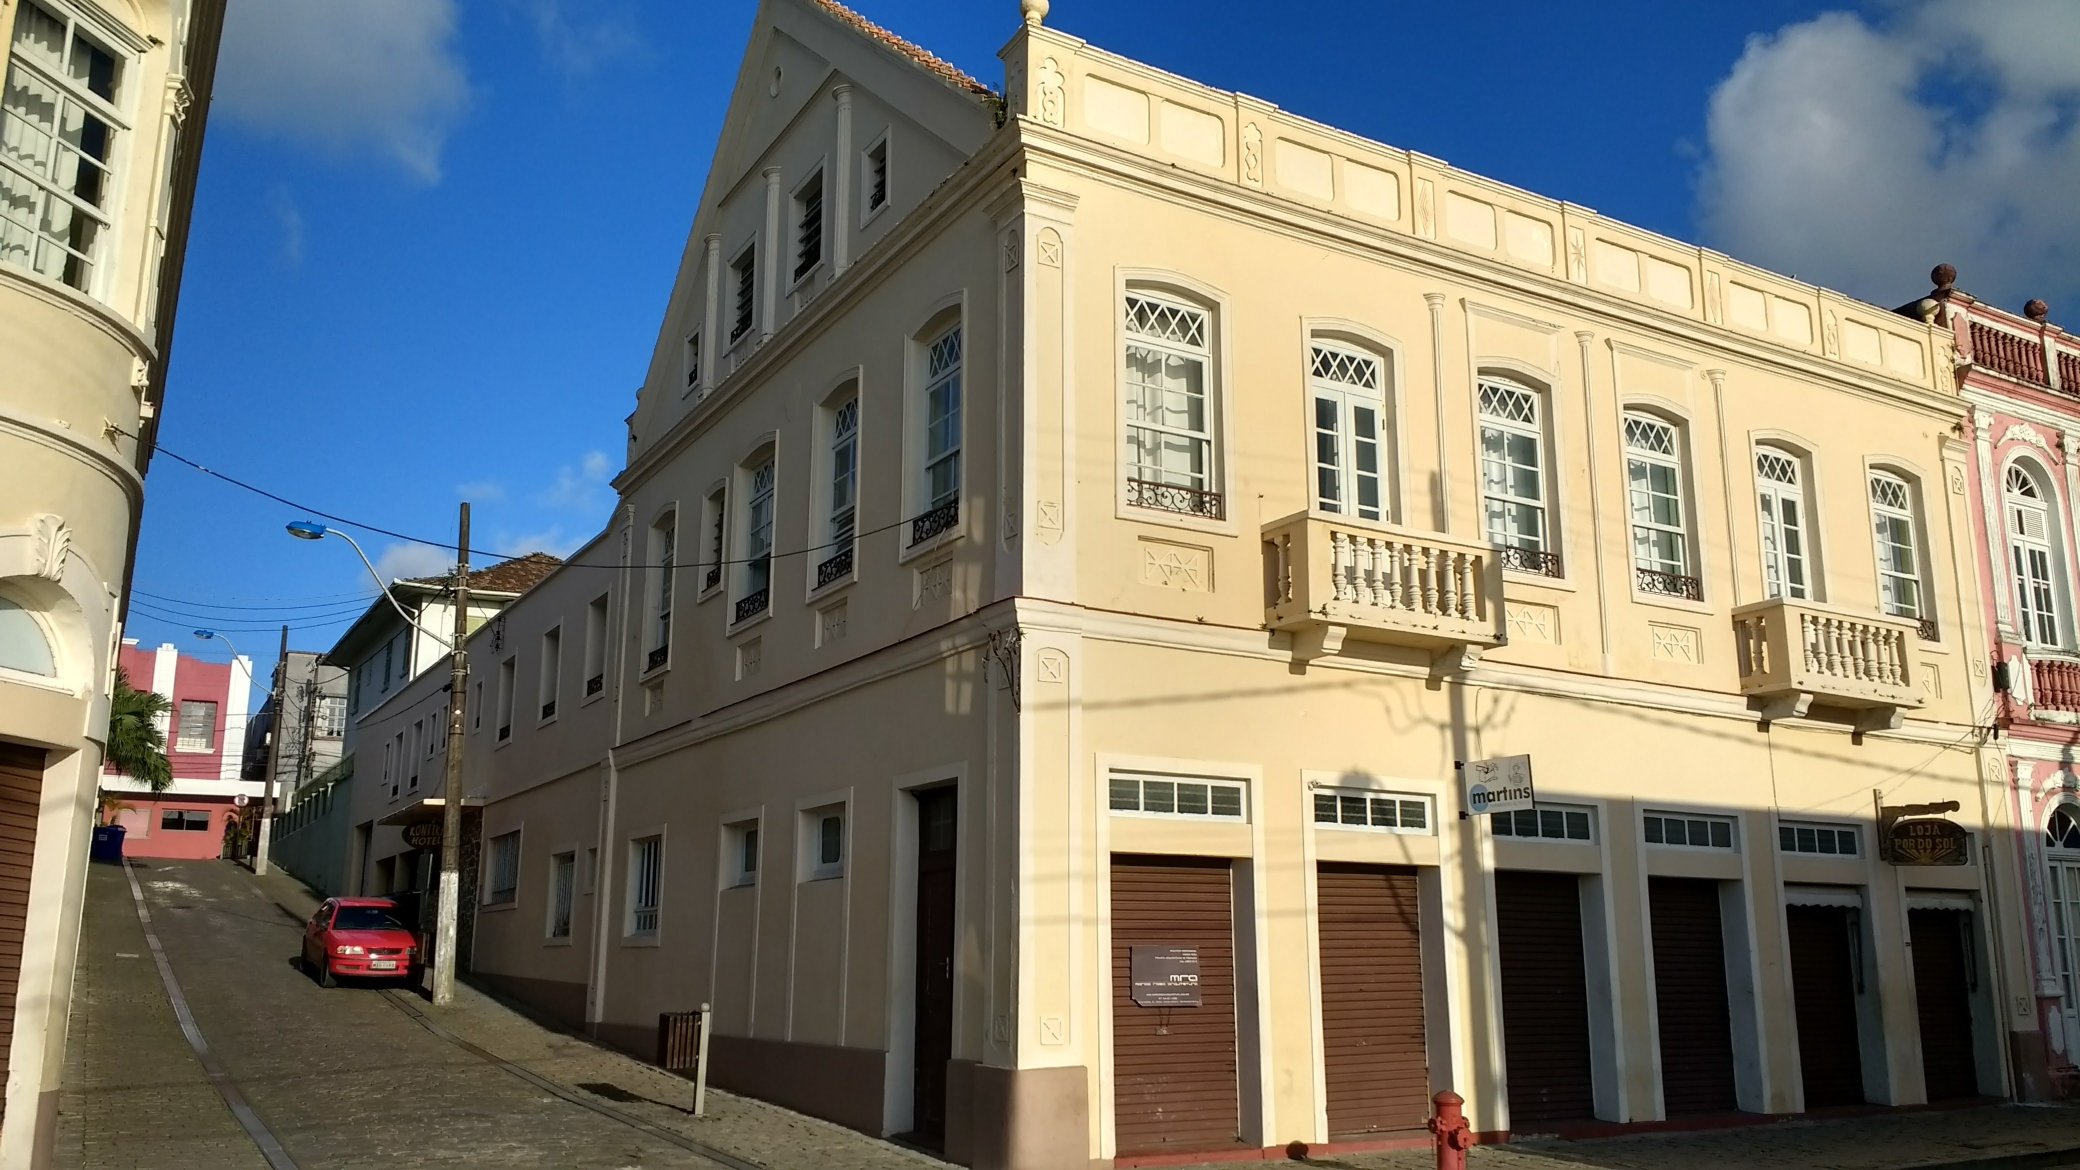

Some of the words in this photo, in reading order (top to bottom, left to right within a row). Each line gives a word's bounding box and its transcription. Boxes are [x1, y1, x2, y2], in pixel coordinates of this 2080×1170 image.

[1472, 786, 1531, 805] martins
[1909, 824, 1941, 836] LOJA
[411, 836, 441, 846] HOTEL
[1917, 838, 1933, 849] DO
[1935, 837, 1957, 849] SOL
